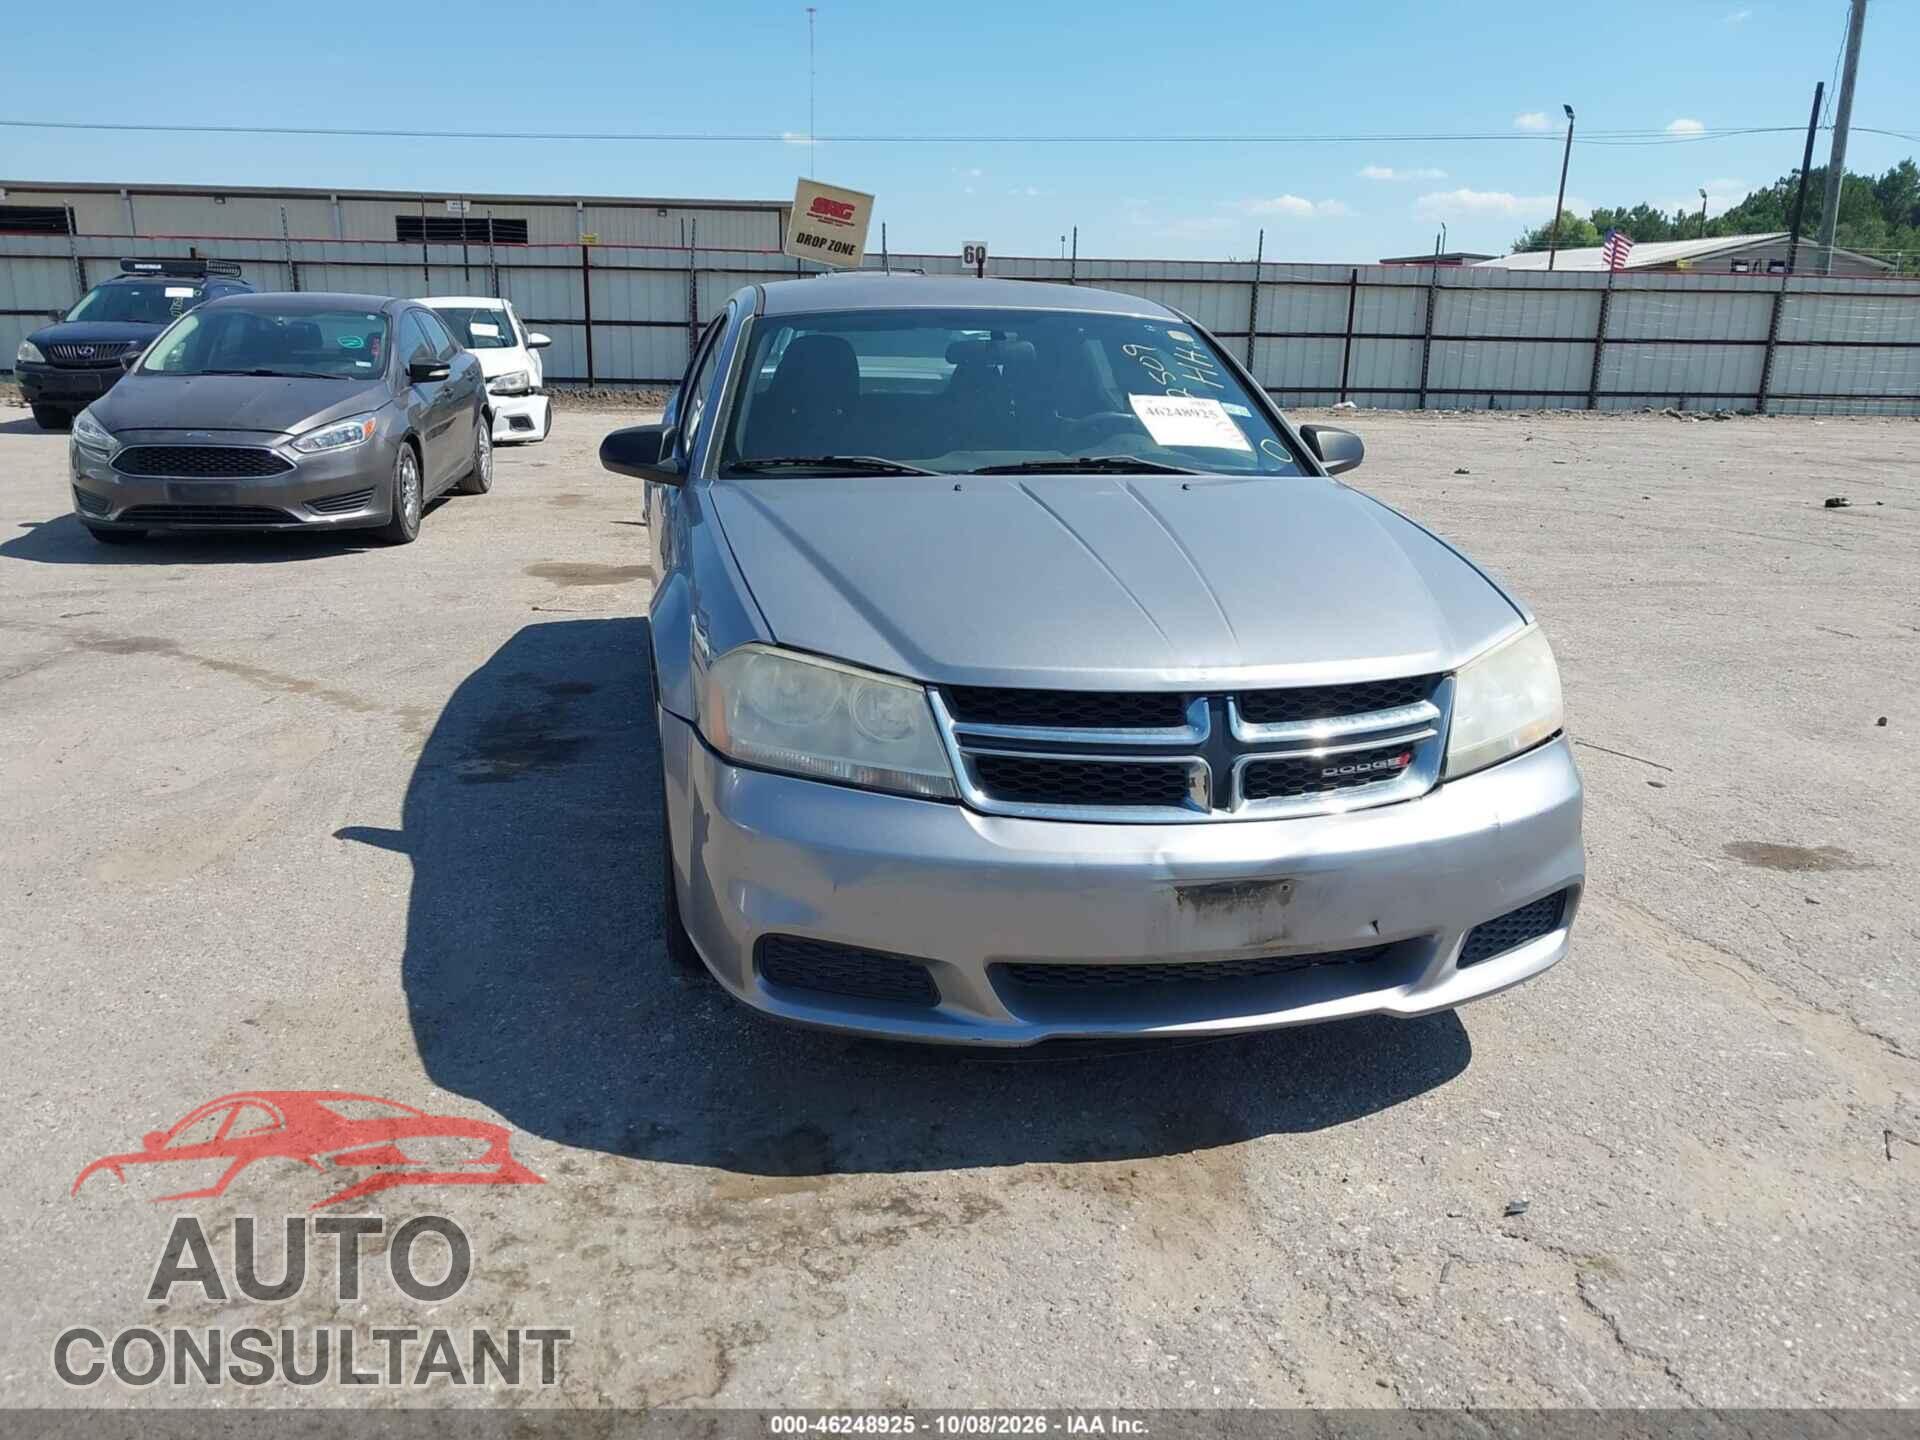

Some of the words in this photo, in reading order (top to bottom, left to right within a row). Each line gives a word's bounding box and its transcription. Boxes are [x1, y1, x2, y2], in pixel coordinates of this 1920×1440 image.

[796, 231, 828, 249] DROP
[827, 239, 857, 256] ZONE
[963, 245, 986, 265] 60
[1322, 756, 1401, 778] DODGE
